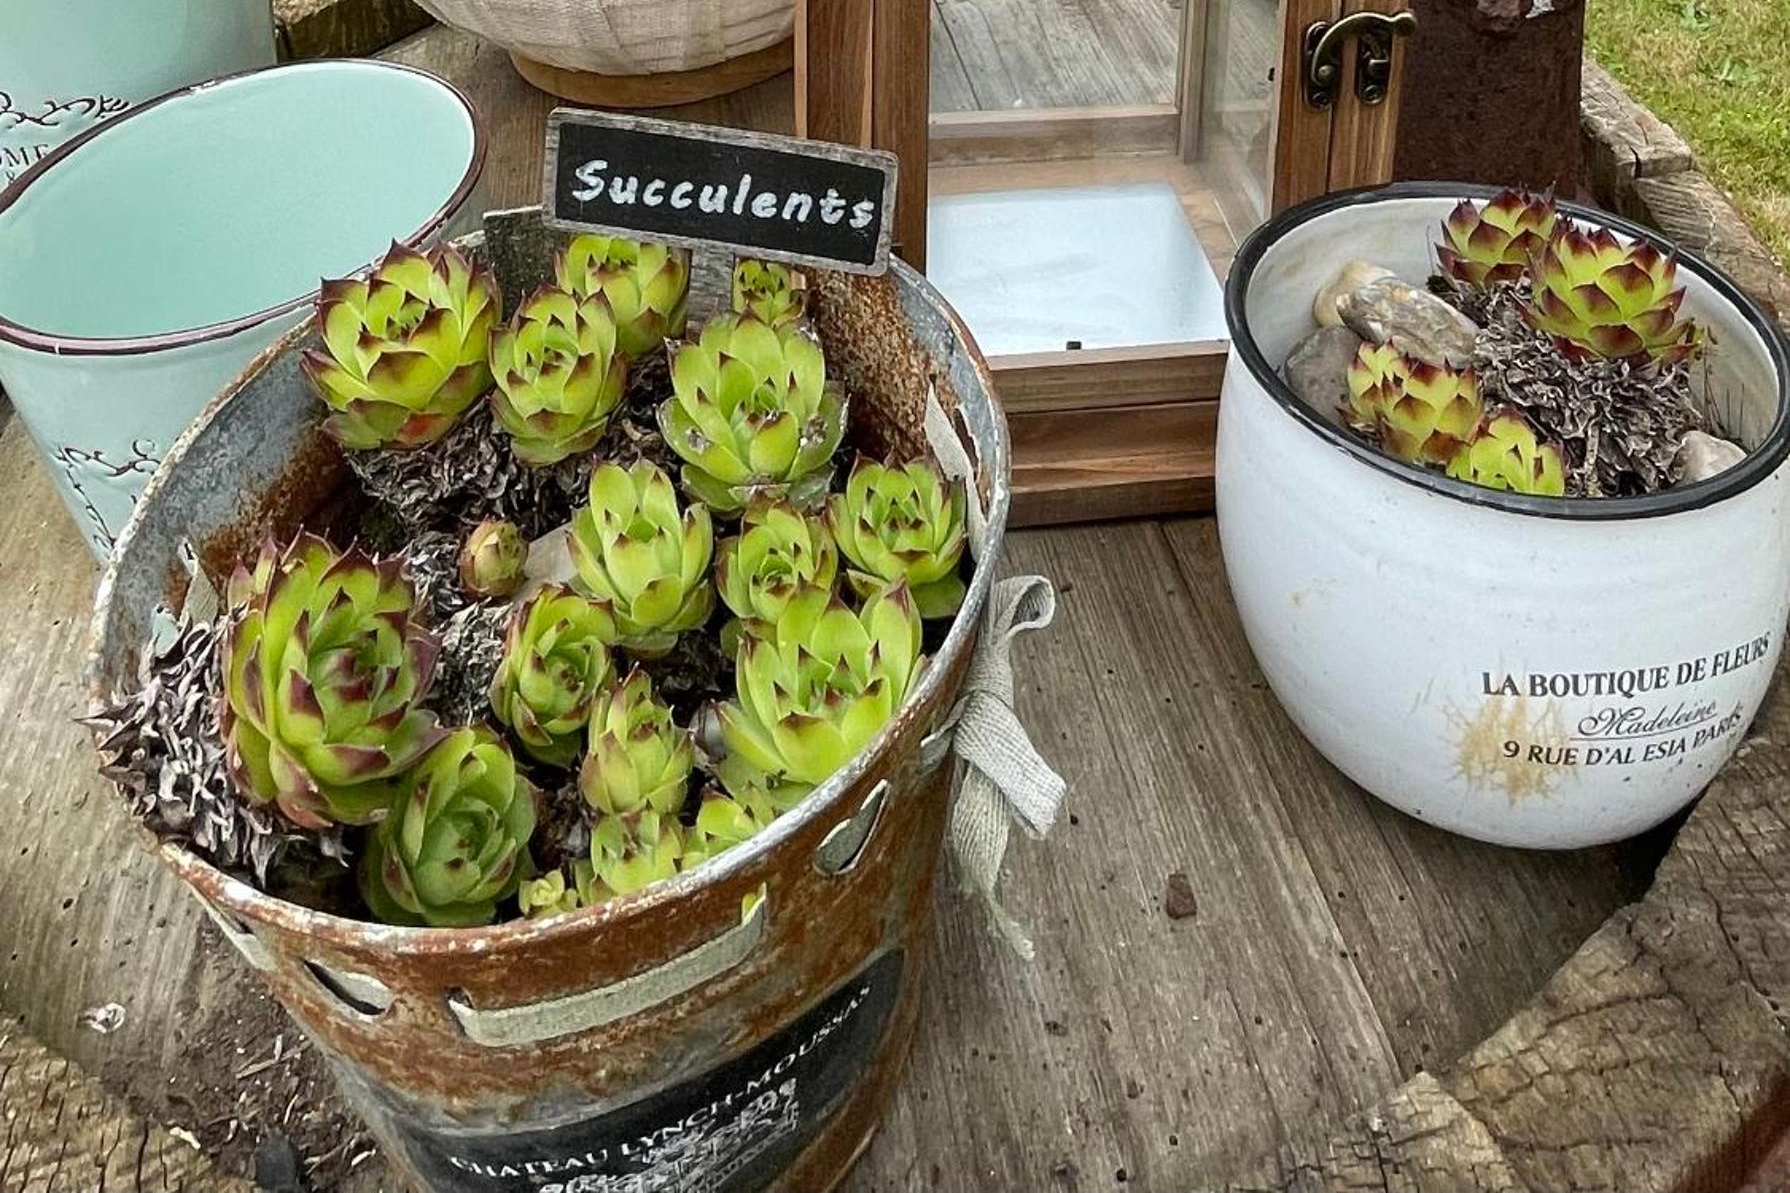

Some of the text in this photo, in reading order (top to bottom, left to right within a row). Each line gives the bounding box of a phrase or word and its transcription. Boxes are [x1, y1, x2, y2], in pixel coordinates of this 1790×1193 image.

[572, 158, 875, 230] Succulents
[1482, 631, 1772, 699] LA BOUTIQUE DE FLEURS
[1502, 740, 1521, 759] 9
[1527, 744, 1579, 766] RUE
[450, 1149, 609, 1178] CHATEAU
